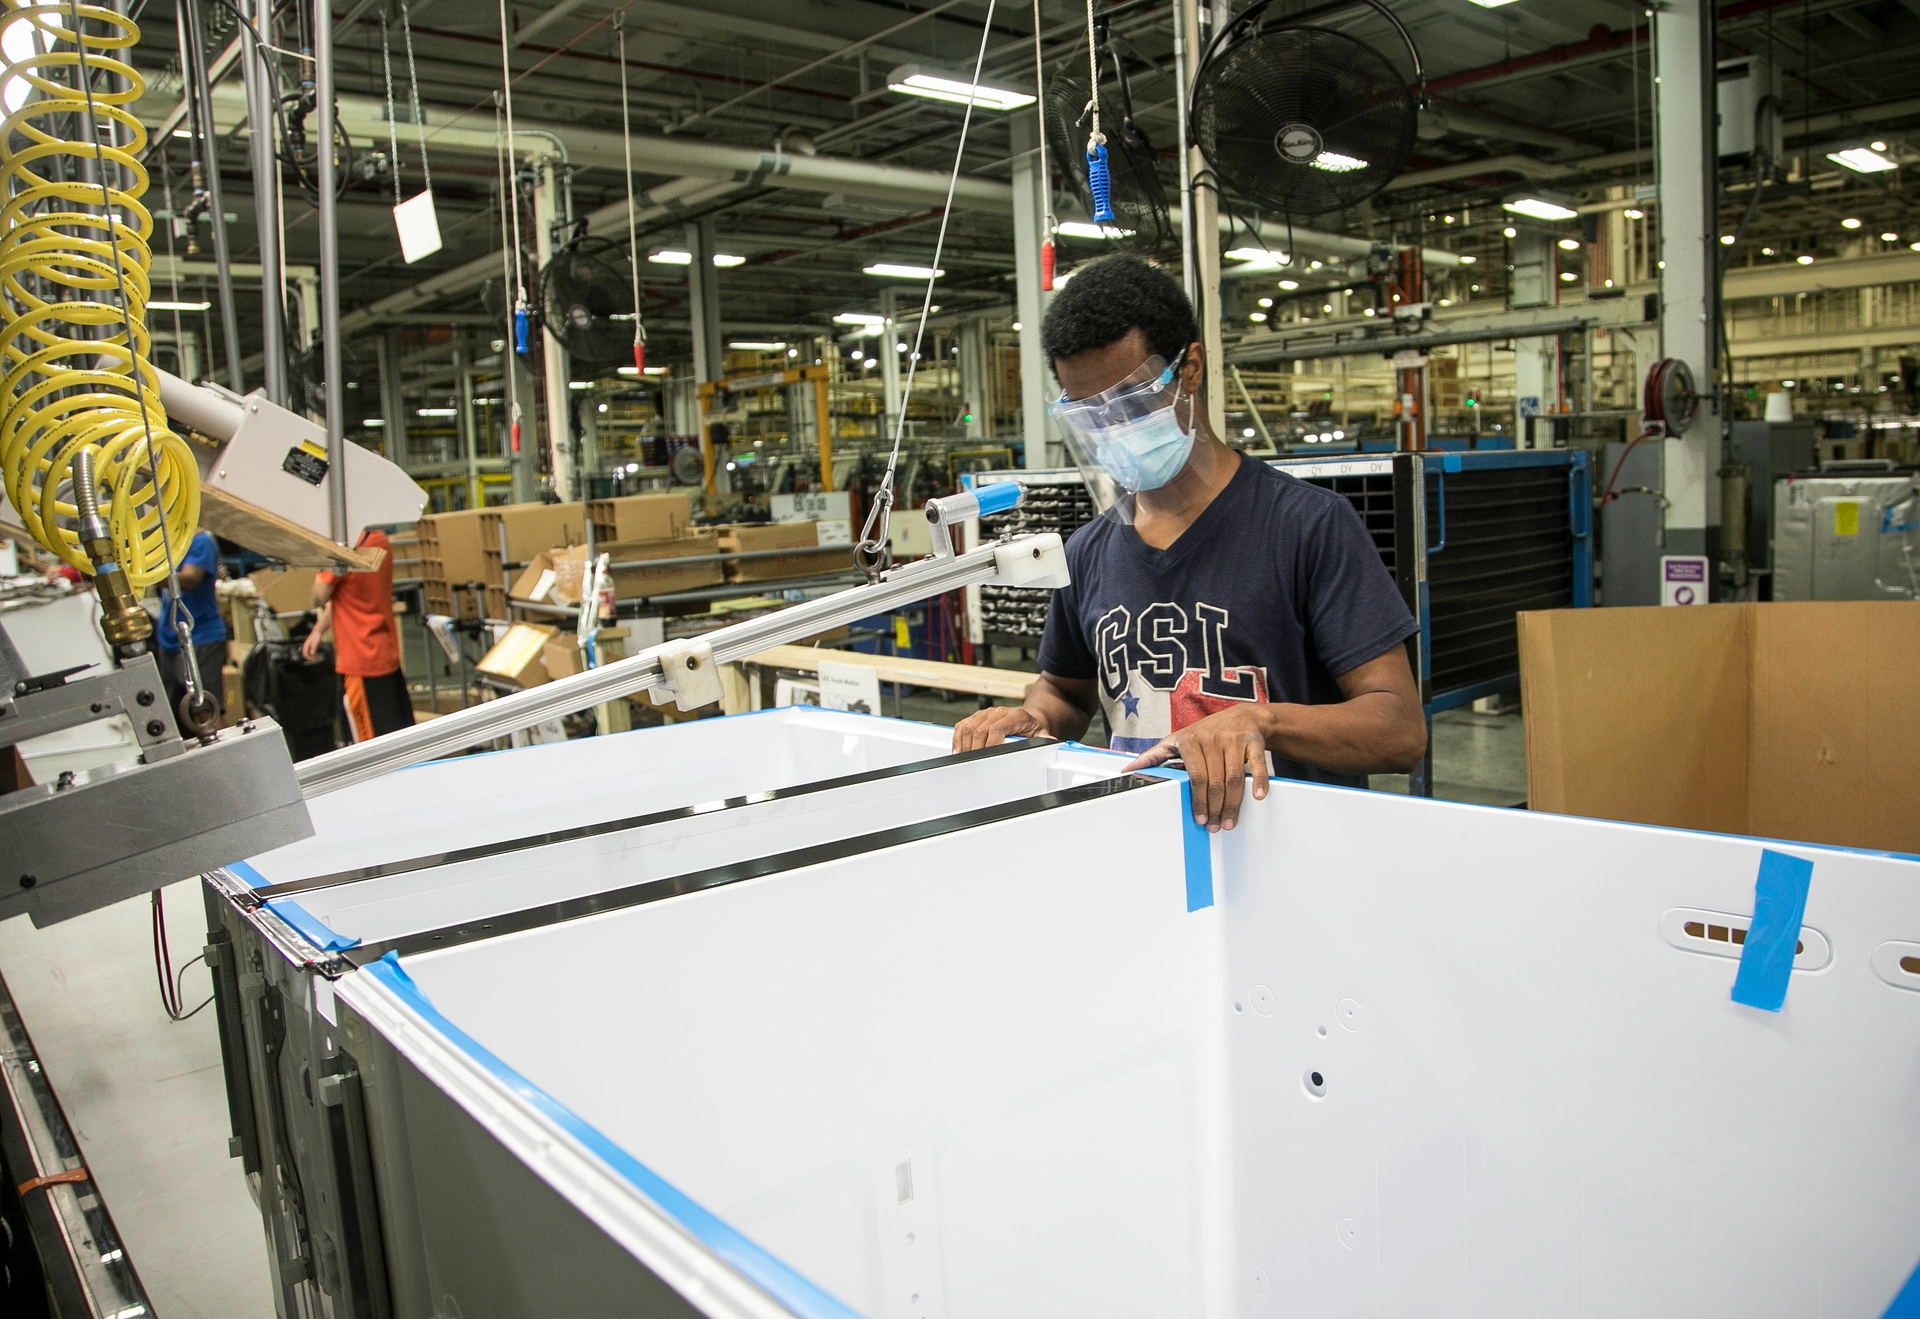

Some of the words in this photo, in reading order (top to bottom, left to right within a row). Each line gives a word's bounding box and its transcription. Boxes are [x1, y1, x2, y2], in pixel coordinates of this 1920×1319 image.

[1311, 466, 1323, 475] DY
[1341, 464, 1353, 473] DY
[1371, 463, 1383, 472] DY
[1095, 602, 1258, 702] GSL
